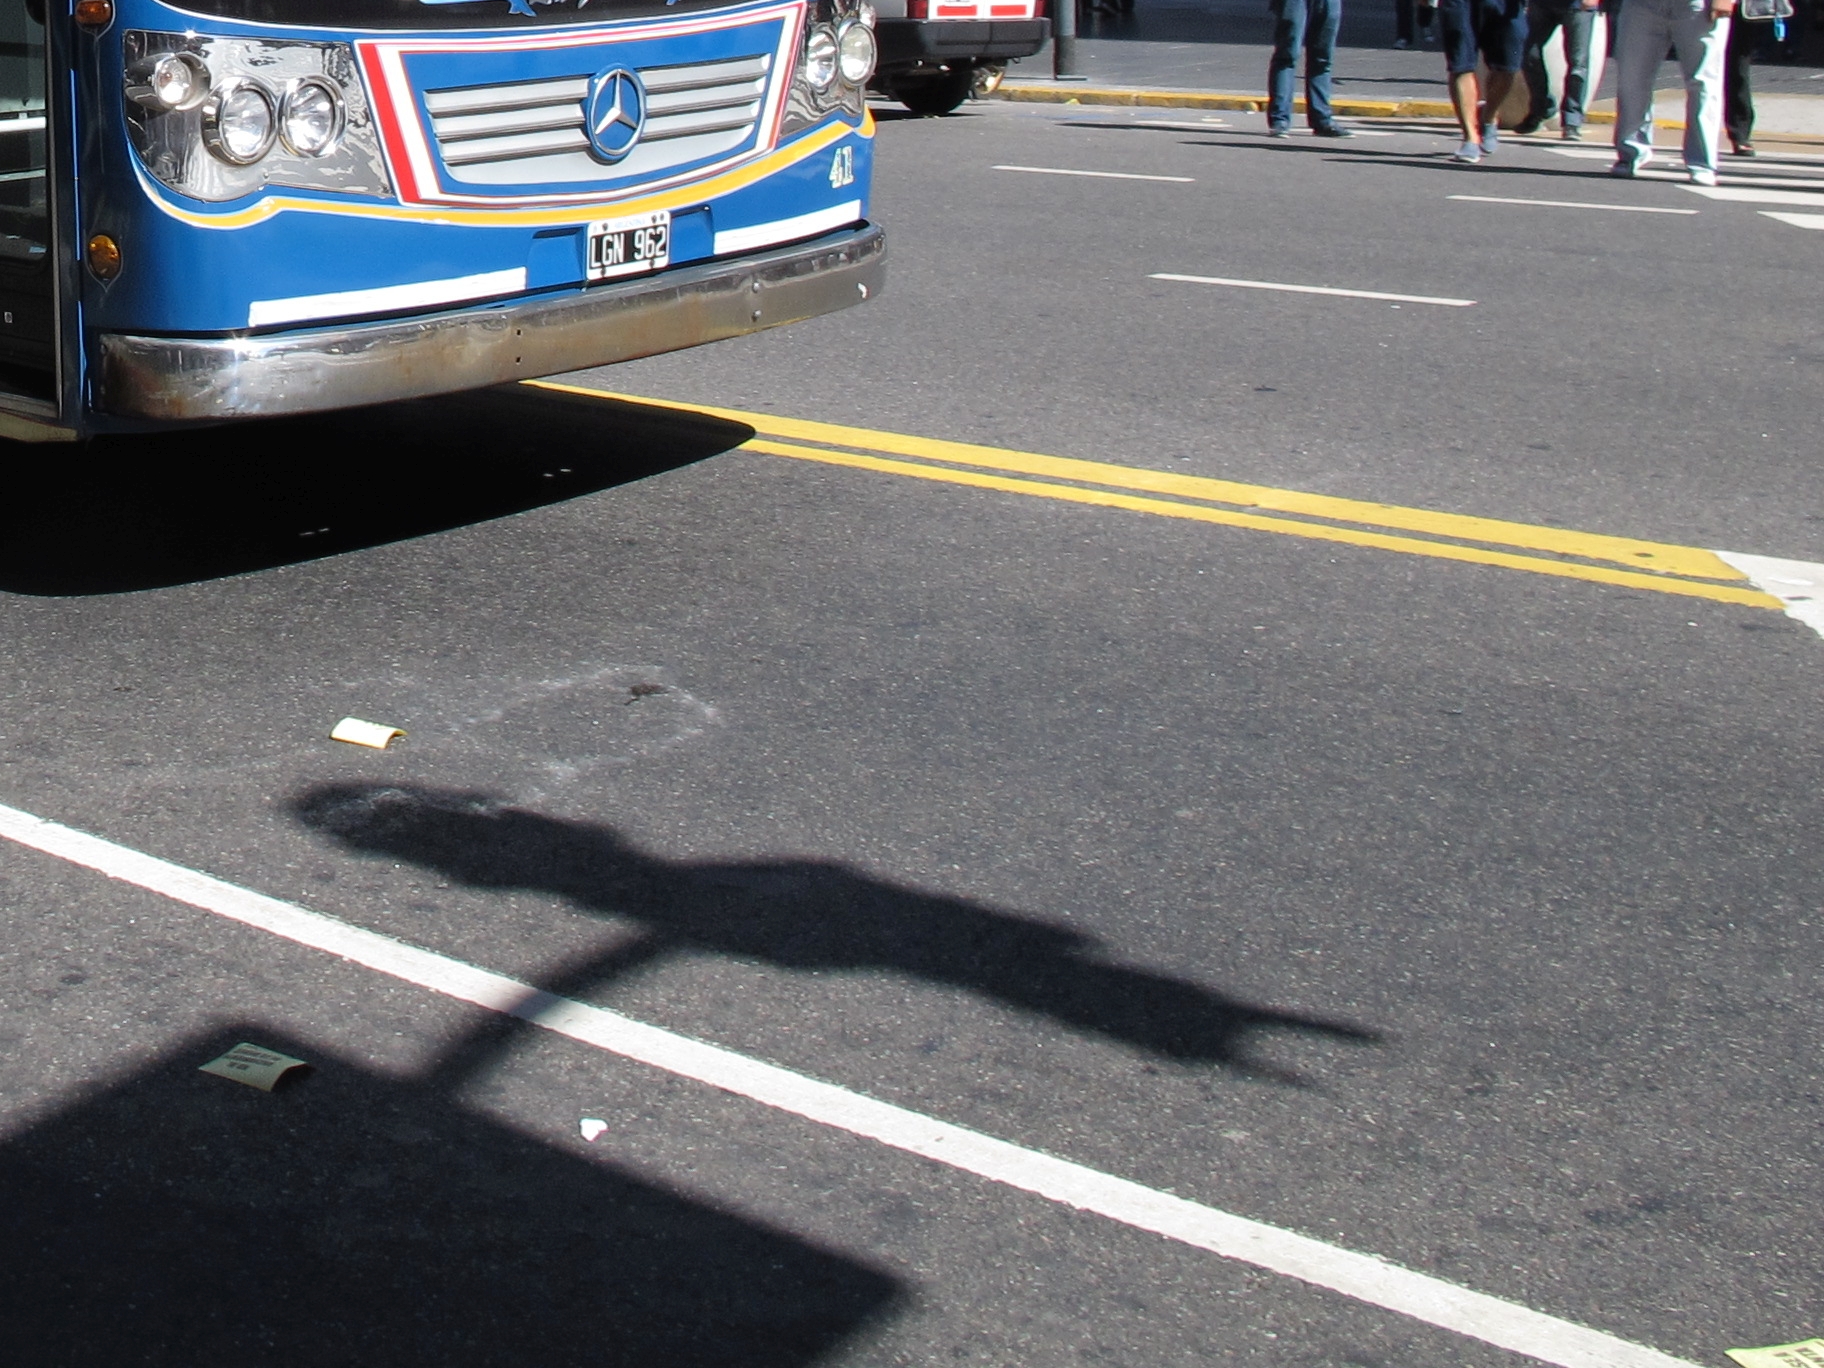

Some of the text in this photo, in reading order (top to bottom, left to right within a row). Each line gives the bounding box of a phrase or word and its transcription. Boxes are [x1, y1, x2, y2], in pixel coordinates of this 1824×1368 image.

[829, 145, 854, 189] 41
[591, 226, 667, 268] LGN 962
